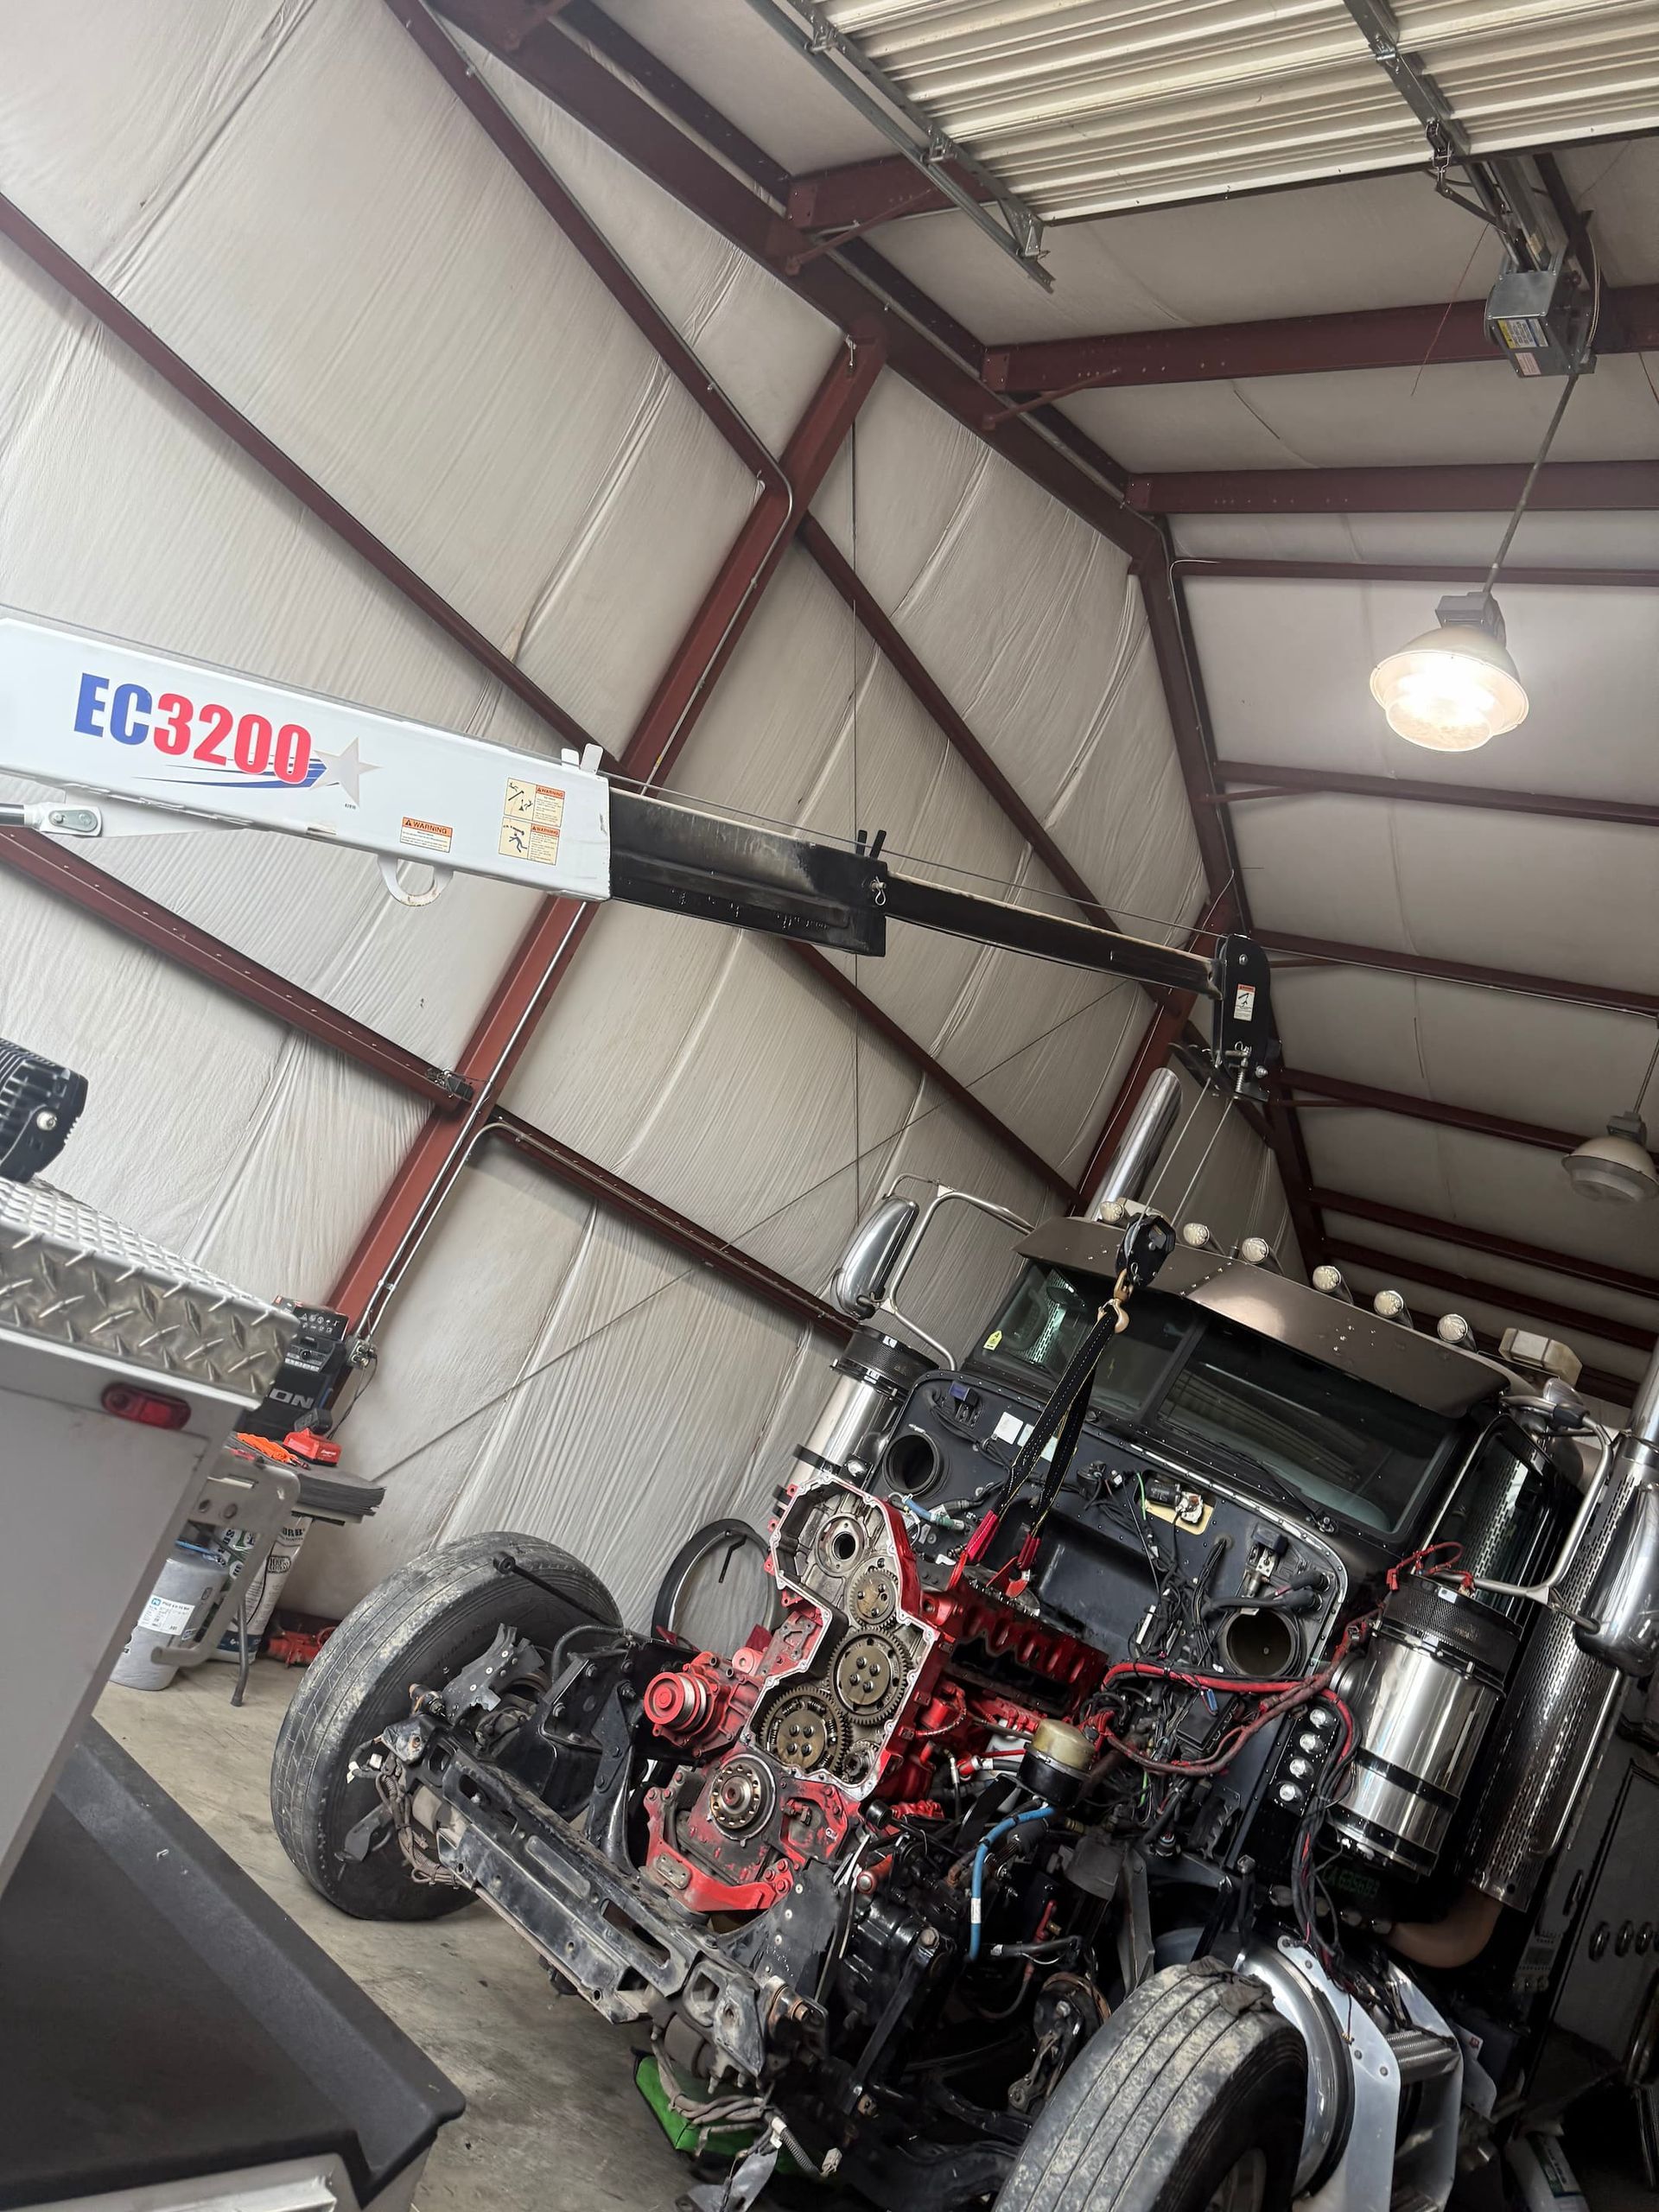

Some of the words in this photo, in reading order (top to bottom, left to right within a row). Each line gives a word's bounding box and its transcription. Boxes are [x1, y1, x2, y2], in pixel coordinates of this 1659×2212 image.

[73, 672, 312, 785] EC3200
[541, 788, 563, 798] WARNING
[413, 821, 448, 835] WARNING
[536, 826, 558, 836] WARNING
